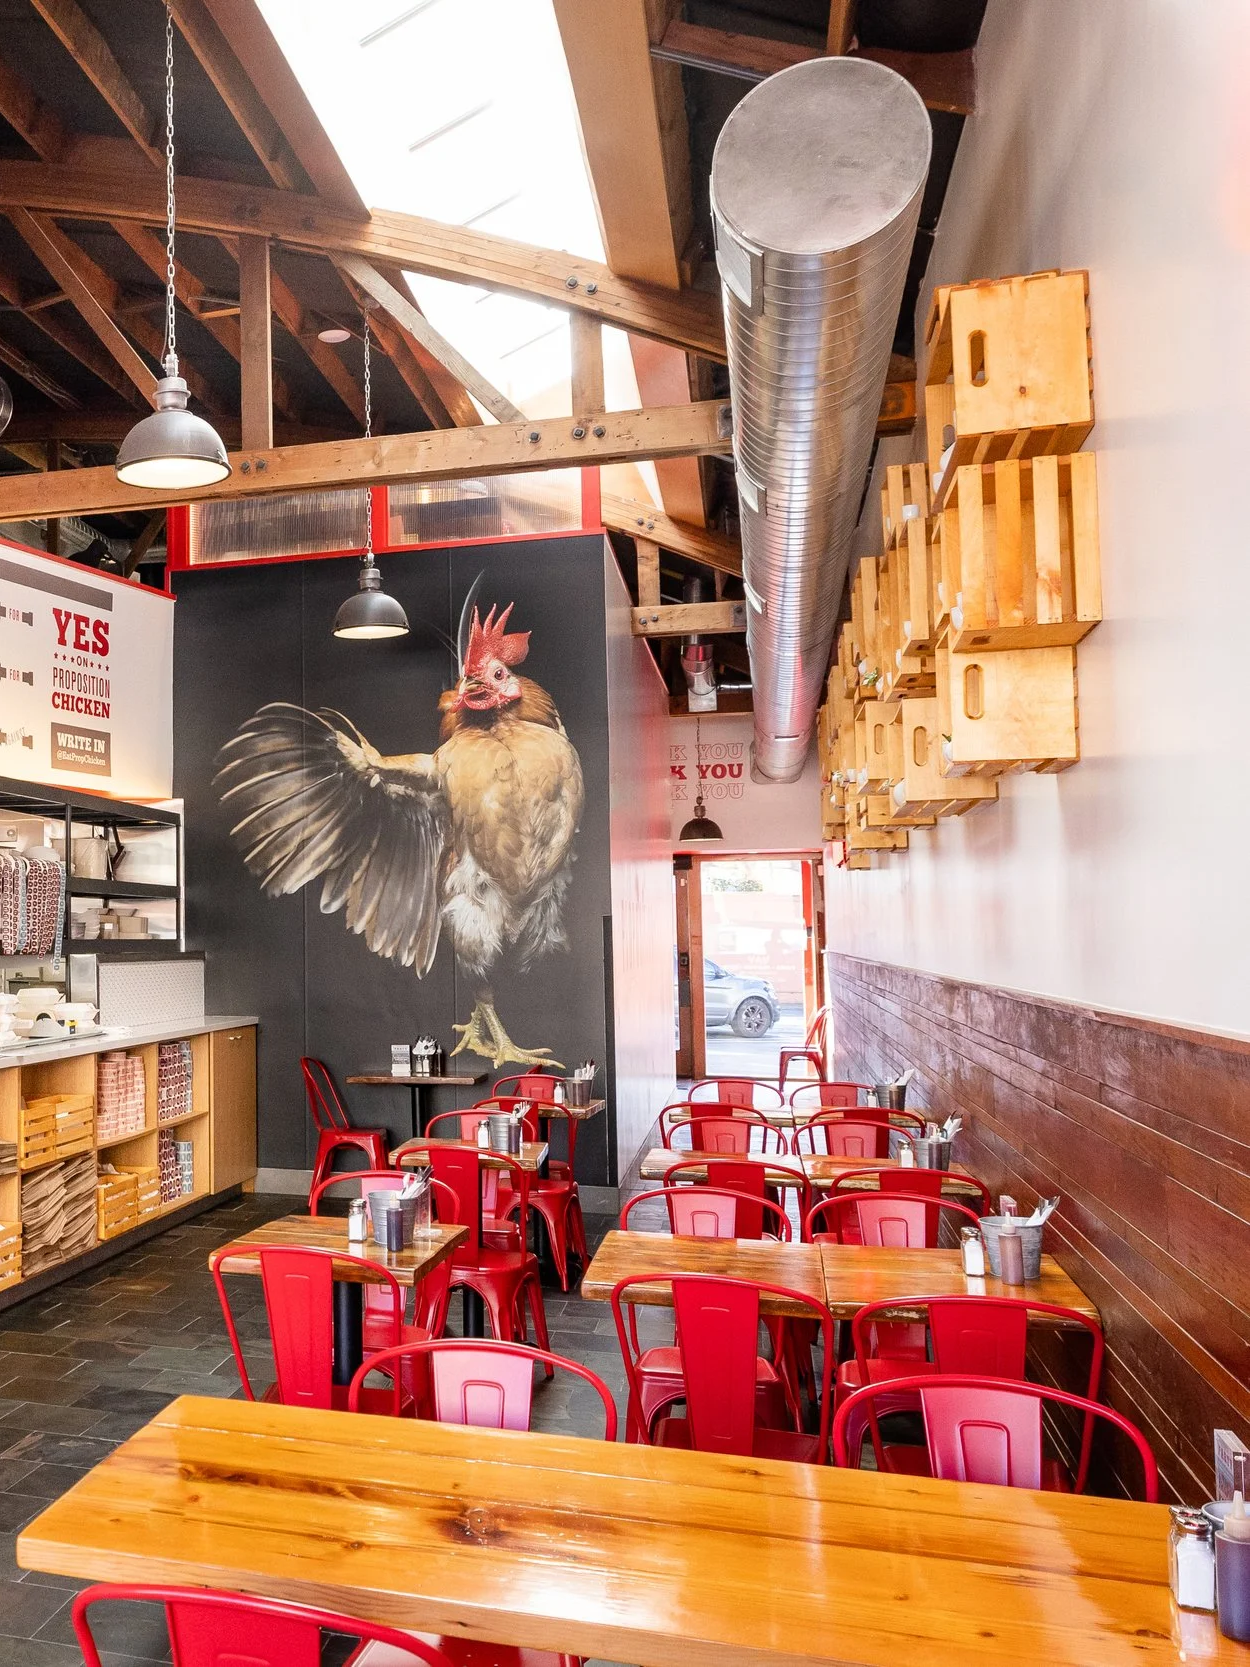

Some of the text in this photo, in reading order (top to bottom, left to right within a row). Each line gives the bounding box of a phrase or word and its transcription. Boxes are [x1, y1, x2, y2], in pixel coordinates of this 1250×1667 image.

[9, 608, 20, 622] FOR
[53, 608, 109, 657] YES
[77, 656, 88, 667] ON
[10, 669, 19, 681] FOR
[53, 667, 110, 699] PROPOSITION
[52, 692, 110, 718] CHICKEN
[57, 732, 105, 753] WRITE IN
[57, 750, 106, 766] @EatPropChicken
[695, 743, 744, 760] YOU
[696, 764, 743, 779] YOU
[696, 783, 744, 799] YOU
